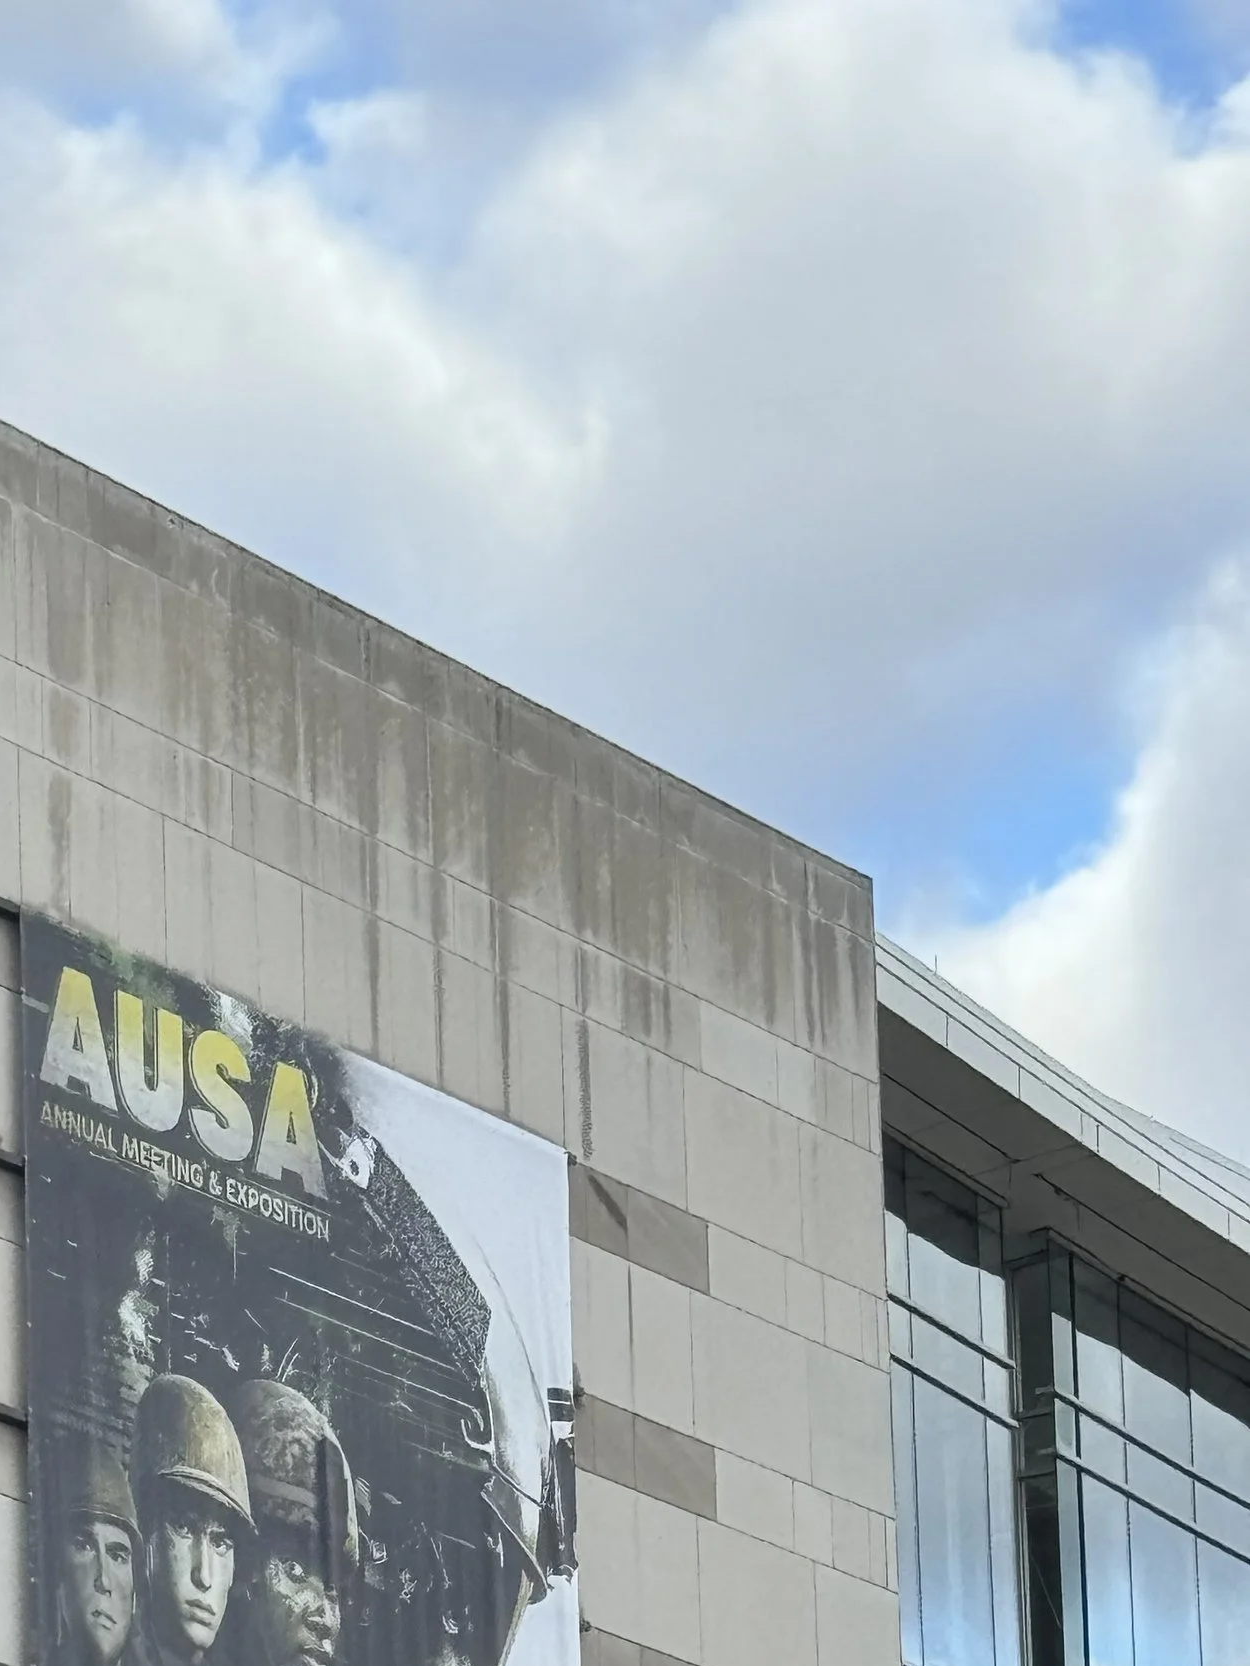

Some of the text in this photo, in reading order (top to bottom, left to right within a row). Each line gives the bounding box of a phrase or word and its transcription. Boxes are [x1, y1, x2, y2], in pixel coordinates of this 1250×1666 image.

[40, 966, 328, 1201] AUSA
[41, 1101, 330, 1242] ANNUAL MEETING & EXPOSITION
